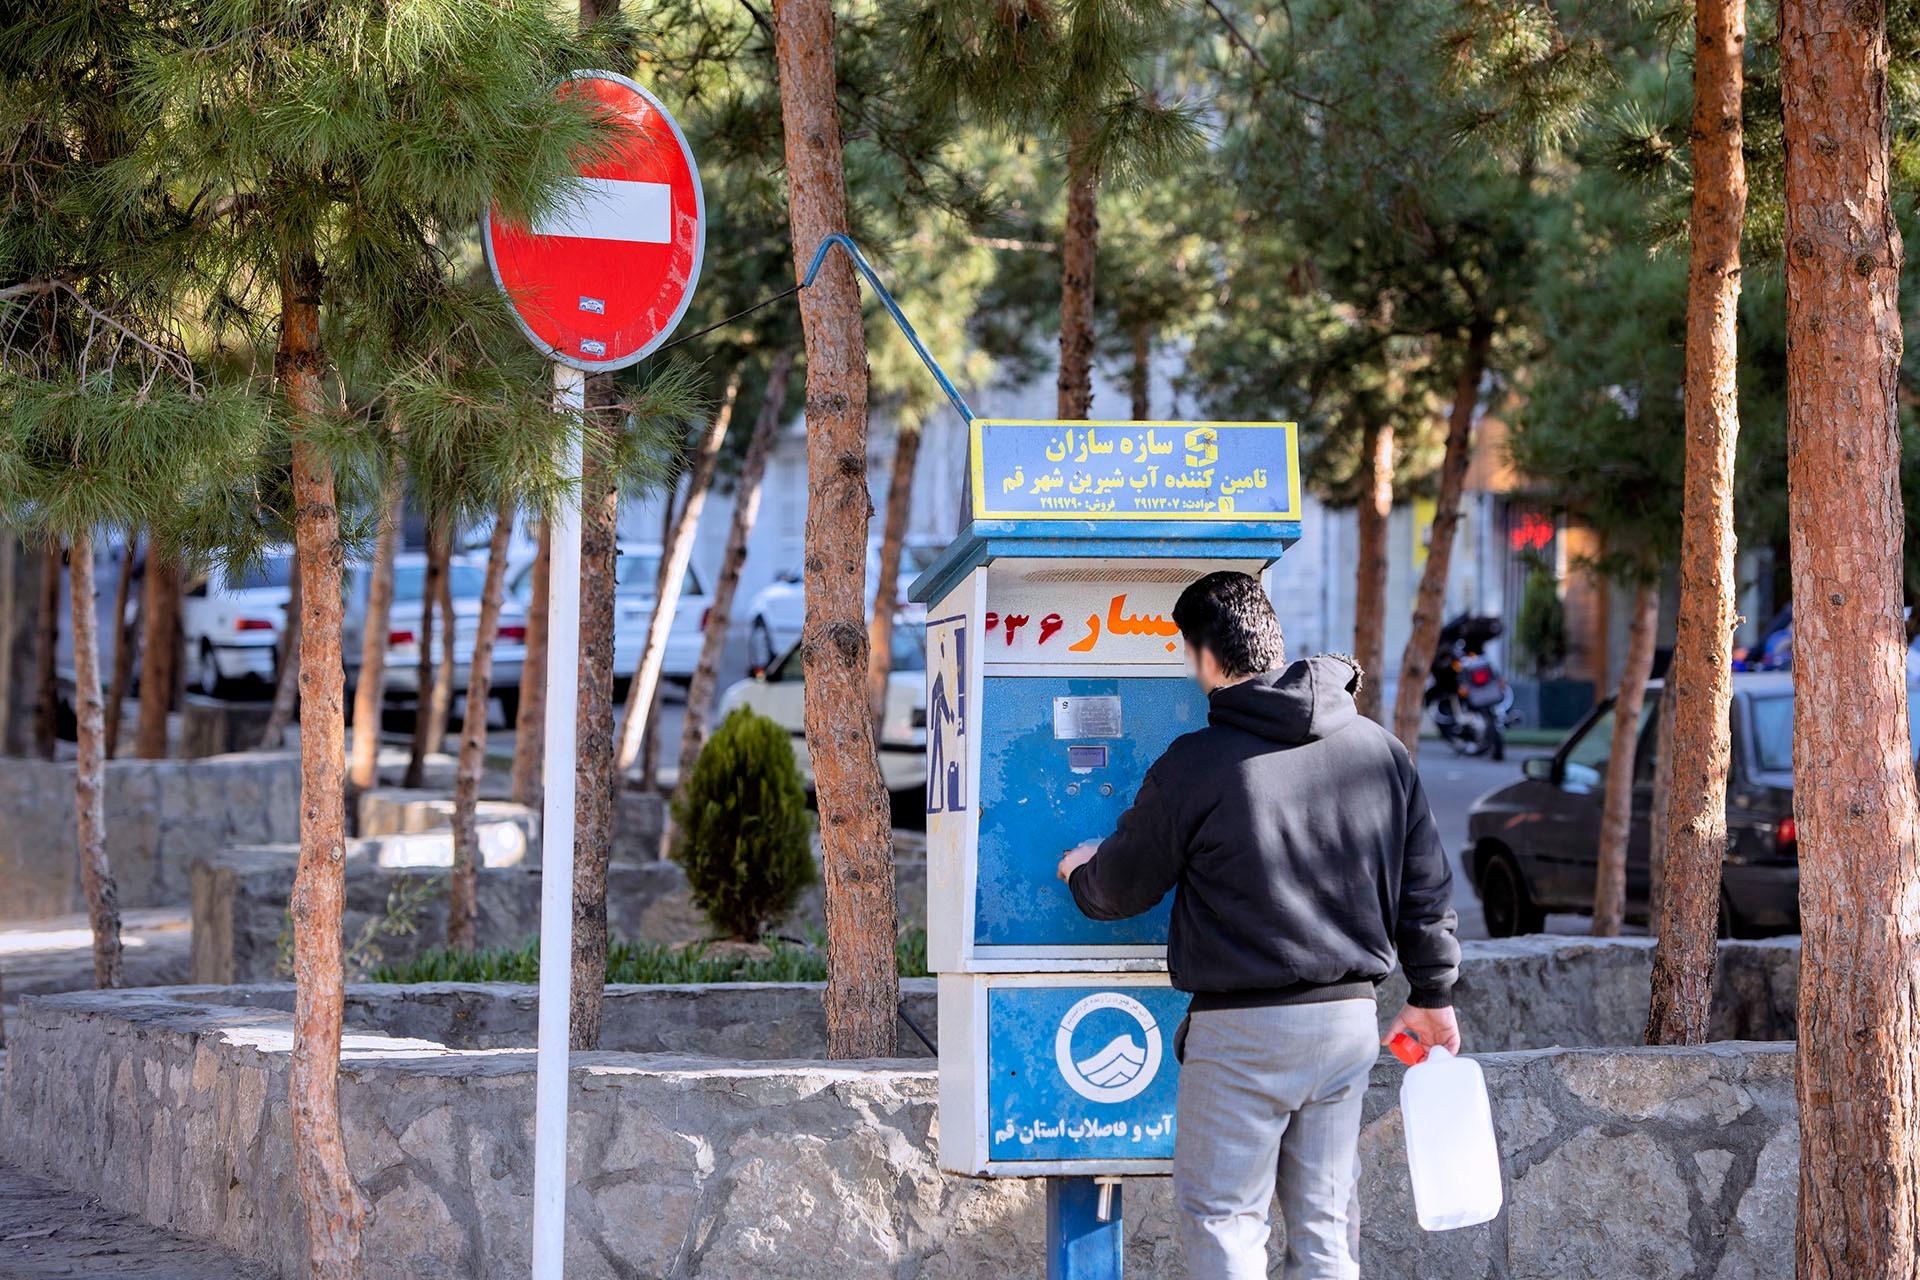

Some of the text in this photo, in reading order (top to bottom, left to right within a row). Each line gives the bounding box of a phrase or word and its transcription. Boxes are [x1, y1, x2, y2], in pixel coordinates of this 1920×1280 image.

[1045, 428, 1173, 463] سازه سازان
[1002, 465, 1268, 495] تامین کننده آب شیرین شهر قم
[1084, 497, 1116, 512] فروش:
[994, 1118, 1015, 1145] قم
[1019, 1118, 1065, 1145] استان
[1131, 1124, 1142, 1143] و
[1145, 1114, 1174, 1141] آب
